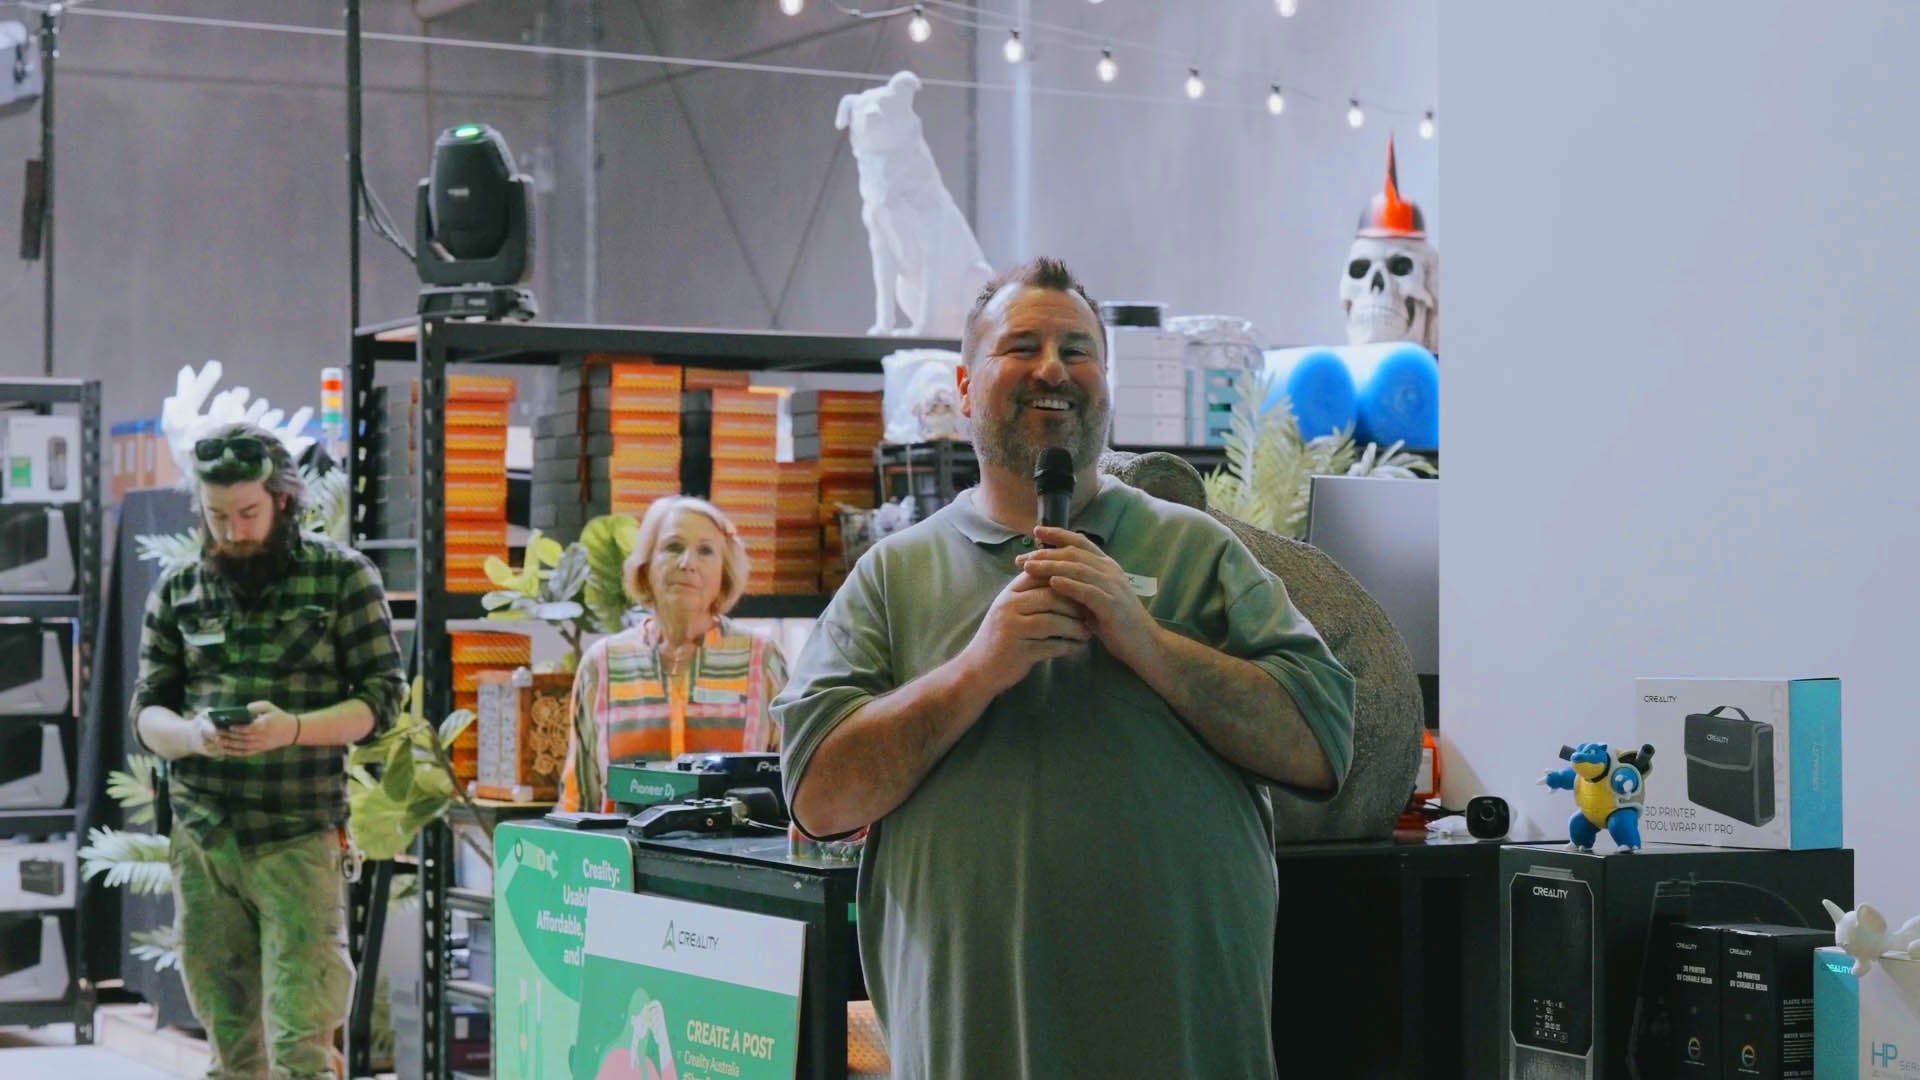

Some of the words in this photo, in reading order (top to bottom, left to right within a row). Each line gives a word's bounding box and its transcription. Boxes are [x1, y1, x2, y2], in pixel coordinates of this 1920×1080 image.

[1643, 695, 1677, 703] CREALITY
[630, 778, 664, 796] Pioneer
[1645, 806, 1657, 817] 3D
[1659, 807, 1696, 818] PRINTER
[1645, 820, 1668, 831] TOOL
[1670, 821, 1697, 832] WRAP
[1698, 823, 1712, 833] KIT
[1714, 824, 1733, 835] PRO
[563, 884, 589, 907] Usabl
[1532, 886, 1569, 899] CREALITY
[536, 909, 584, 941] Affordable,
[679, 930, 719, 951] CREALITY
[563, 946, 580, 967] and
[687, 1019, 730, 1051] CREATE
[731, 1029, 740, 1053] A
[743, 1032, 776, 1060] POST
[684, 1050, 710, 1073] Creality
[1872, 1041, 1898, 1068] HP
